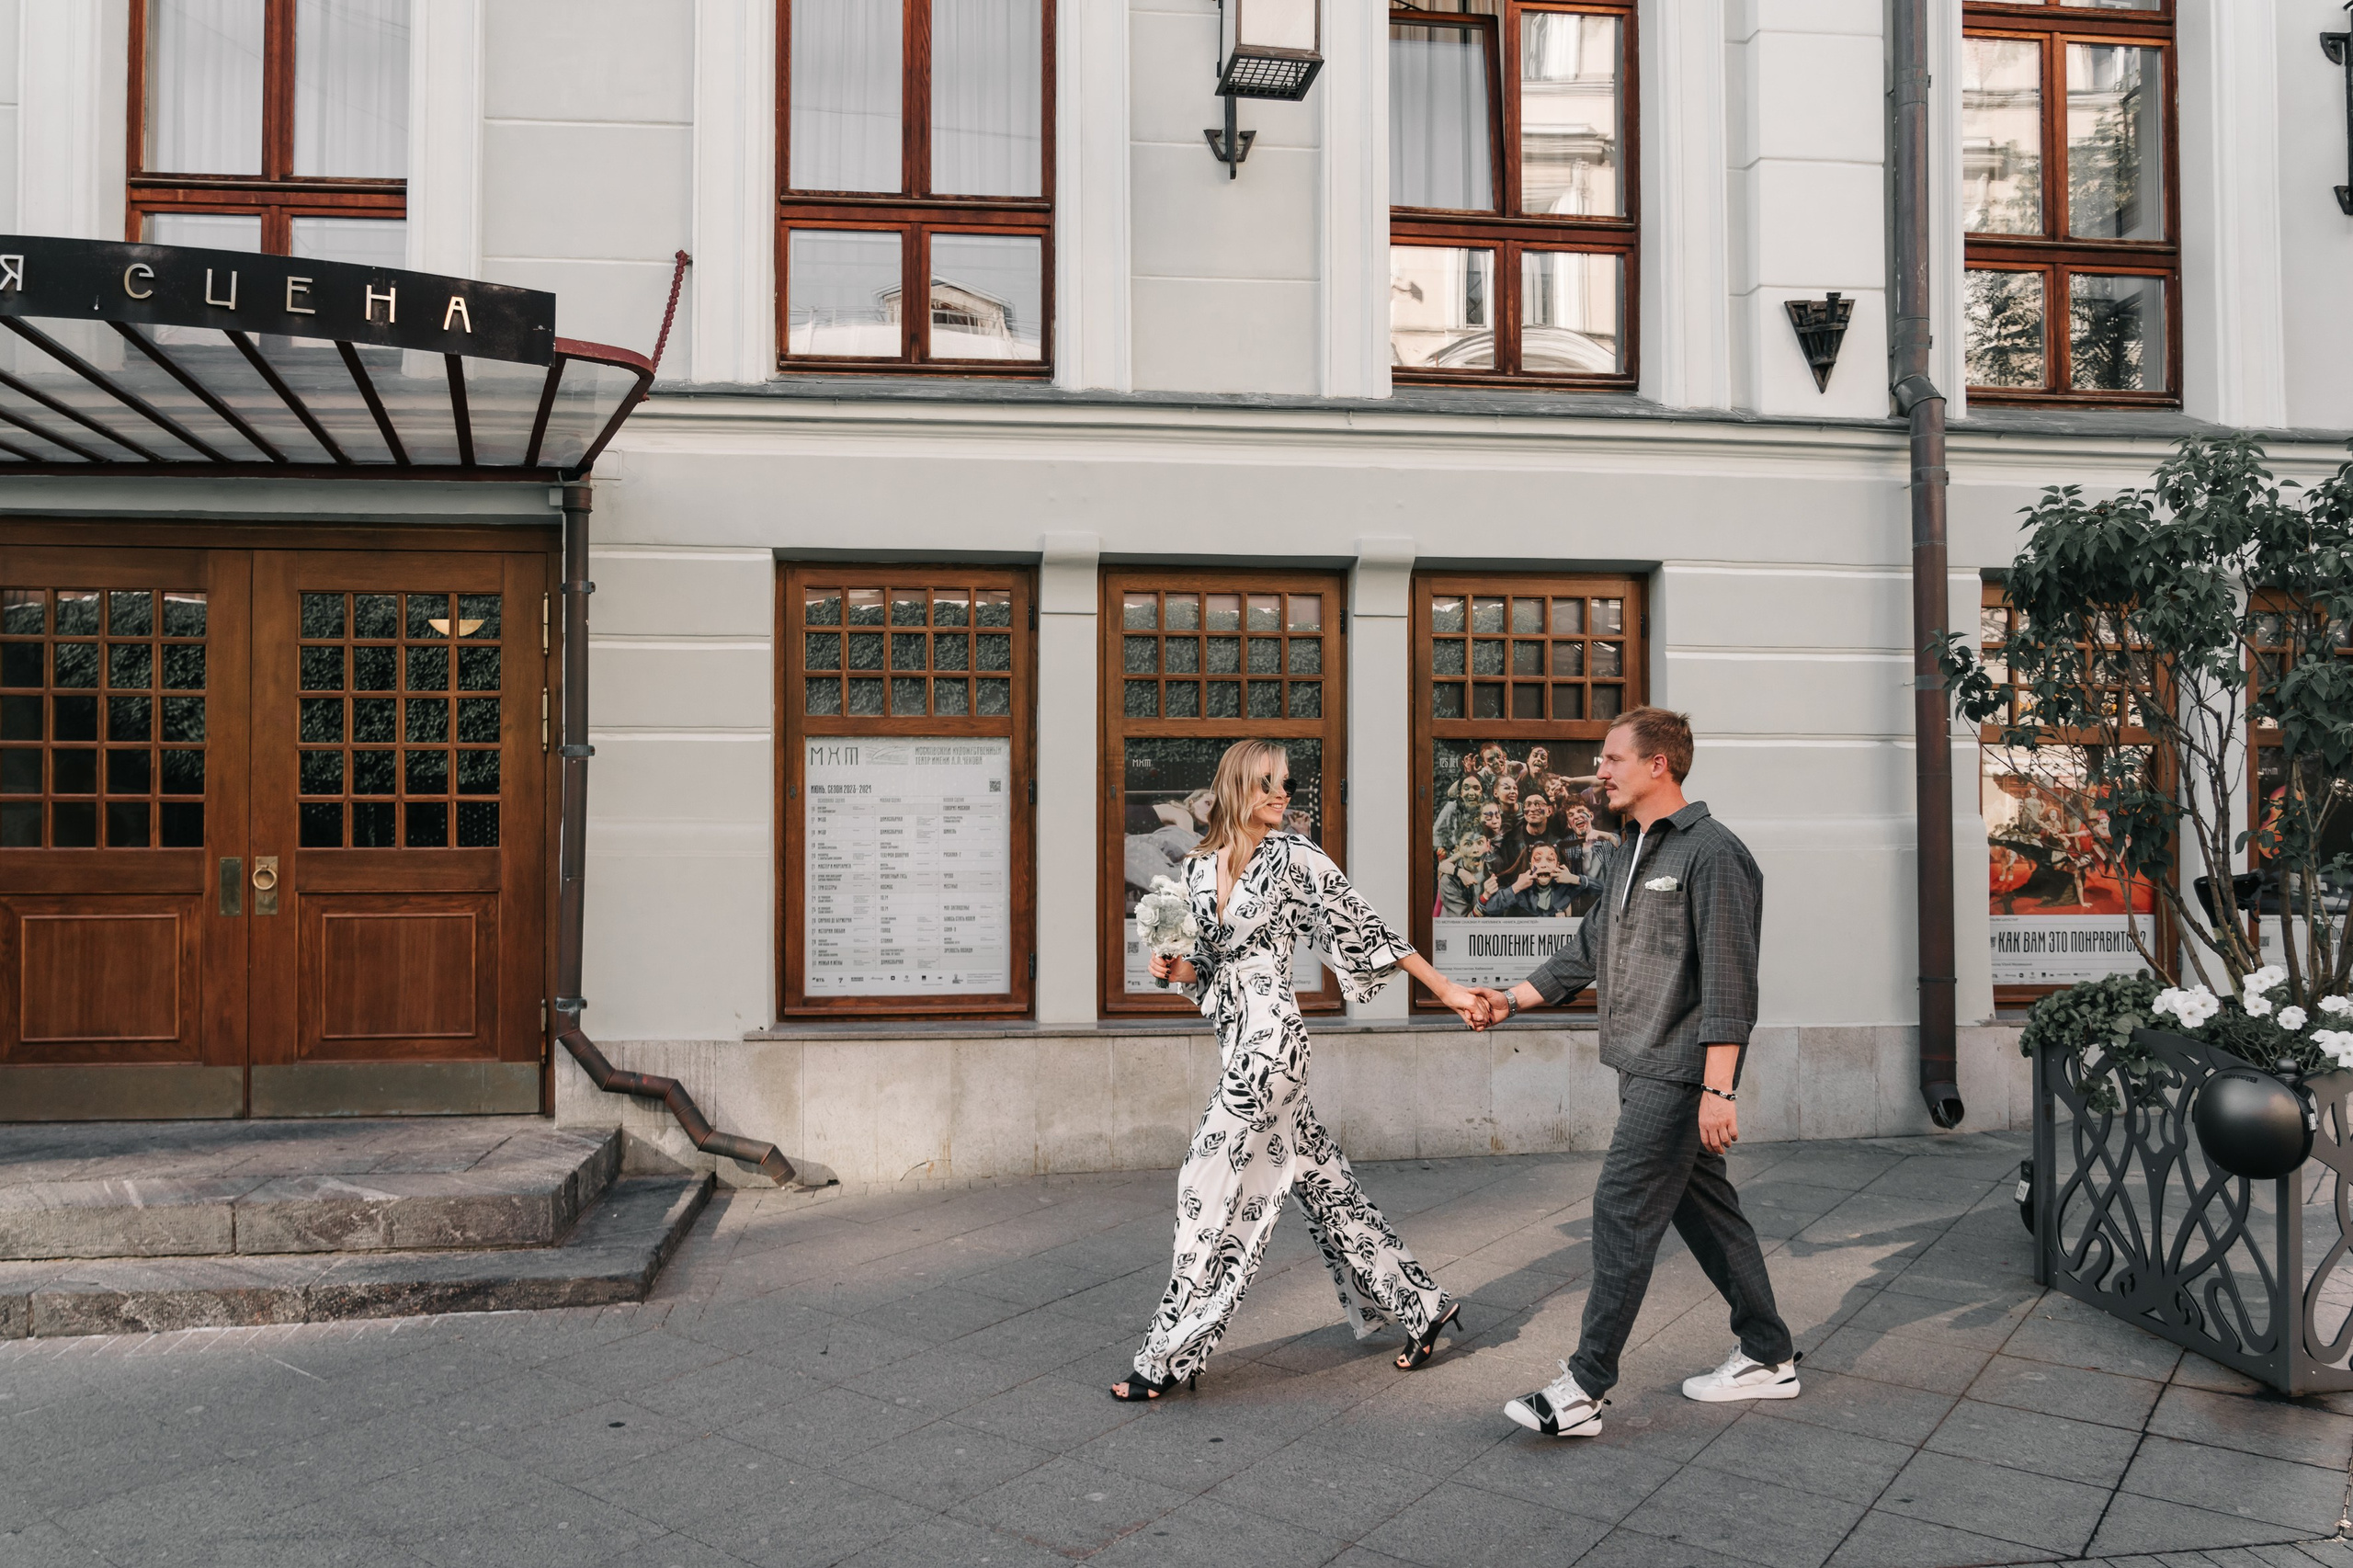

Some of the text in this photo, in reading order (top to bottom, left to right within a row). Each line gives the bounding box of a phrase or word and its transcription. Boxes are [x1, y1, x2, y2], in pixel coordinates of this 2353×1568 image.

[123, 262, 472, 334] СЦЕНА
[811, 746, 858, 766] МХТ
[1132, 758, 1151, 767] МХТ
[1439, 757, 1459, 768] 125 ЛЕТ
[827, 785, 843, 794] СЕЗОН
[1469, 934, 1535, 957] ПОКОЛЕНИЕ
[1998, 931, 2020, 952] КАК
[2023, 931, 2046, 952] ВАМ
[2049, 931, 2067, 952] ЭТО
